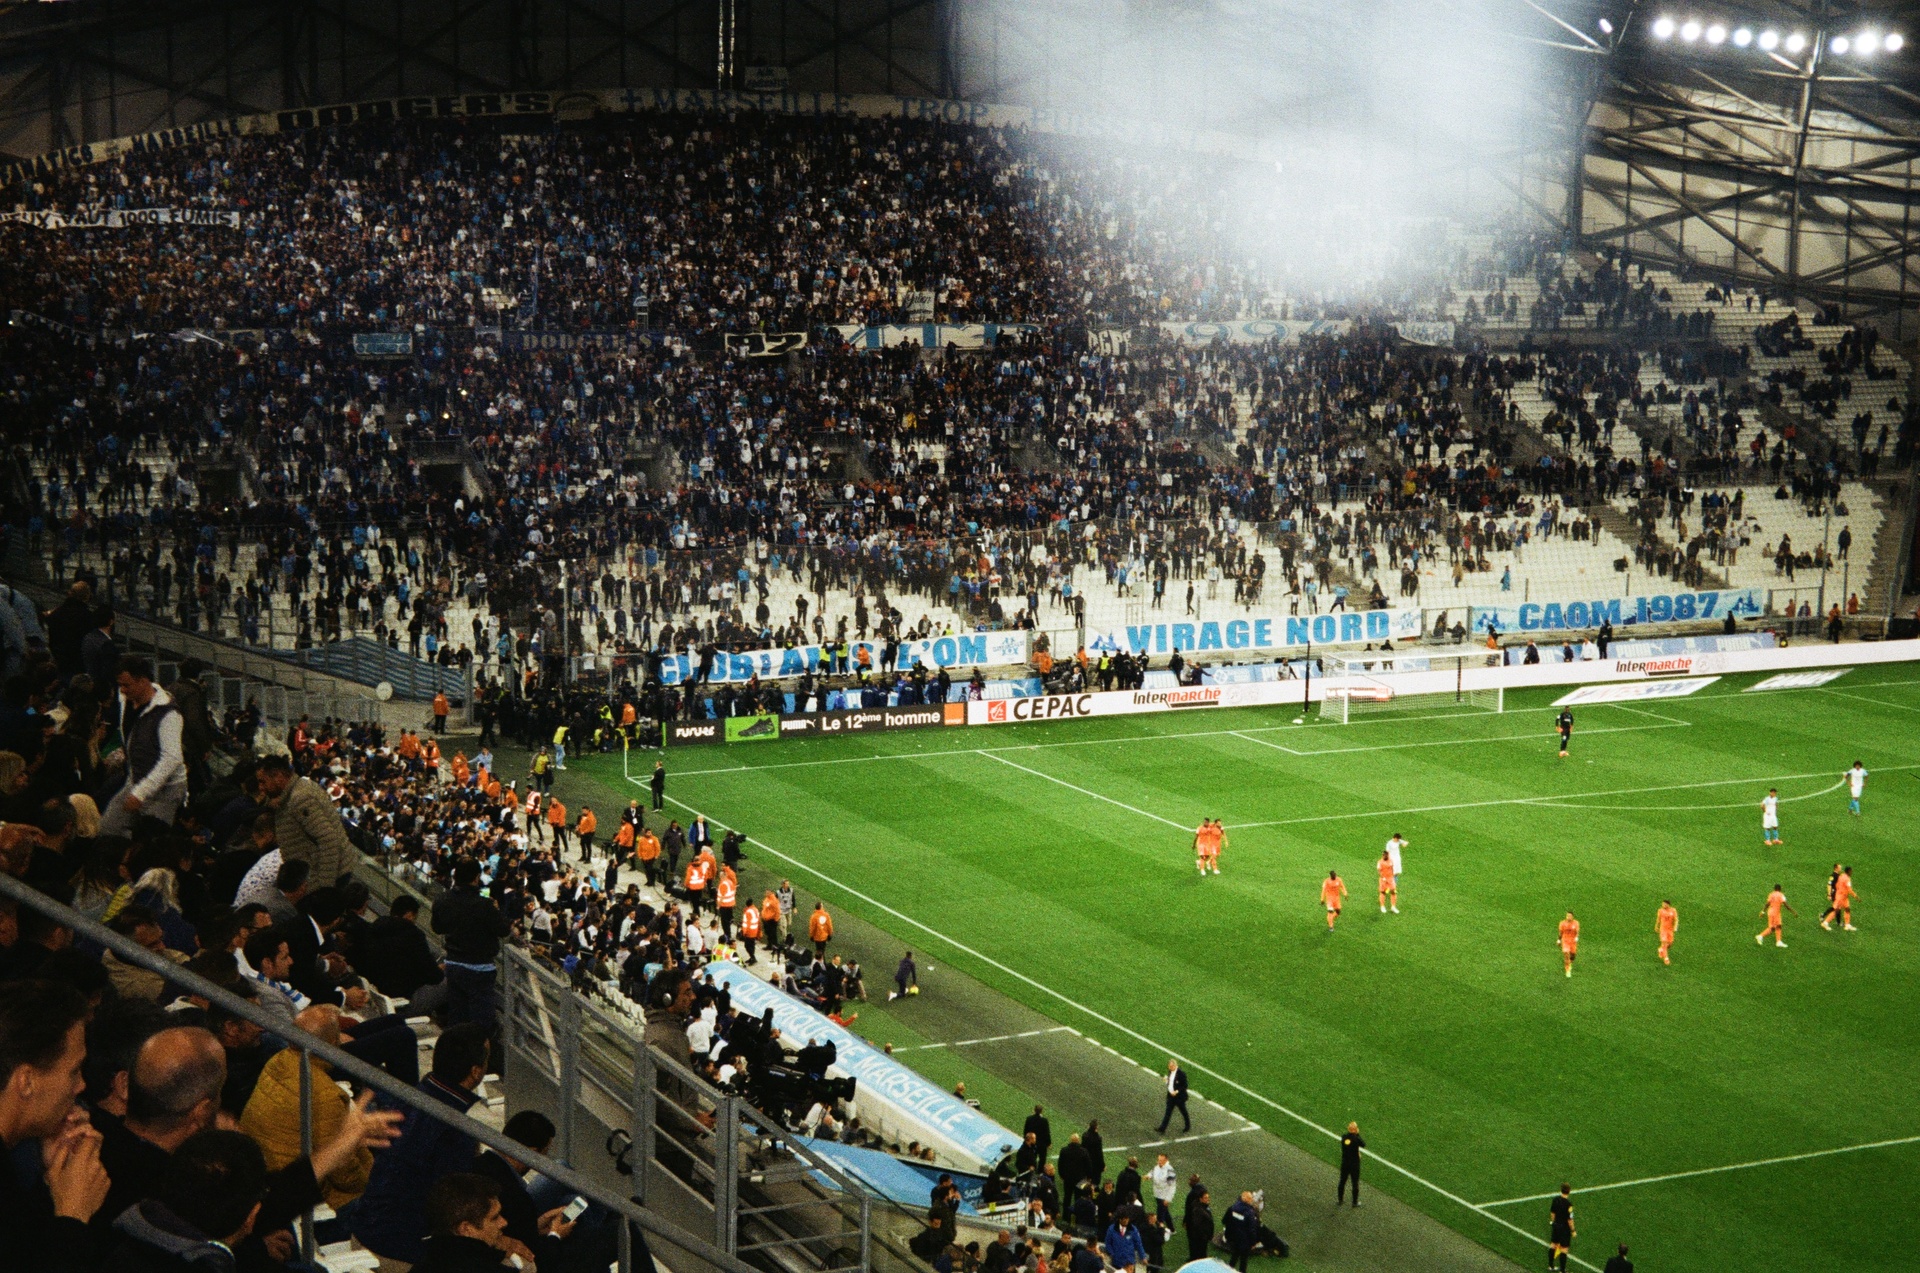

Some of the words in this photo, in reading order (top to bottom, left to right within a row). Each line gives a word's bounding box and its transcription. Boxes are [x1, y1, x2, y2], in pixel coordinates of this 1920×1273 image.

[898, 96, 990, 125] TROP
[170, 208, 232, 225] FUMIS
[1518, 600, 1622, 631] CAOM
[1636, 592, 1720, 624] 1987
[1125, 618, 1273, 653] VIRAGE
[1286, 611, 1391, 645] NORD
[658, 651, 754, 684] CLUB
[897, 635, 988, 670] L'OM
[822, 716, 841, 731] Le
[845, 713, 882, 729] 12ème
[885, 711, 941, 727] homme
[1012, 694, 1092, 720] CEPAC
[734, 981, 837, 1045] OLYMPIQUE
[835, 1037, 867, 1064] DE
[853, 1055, 975, 1131] MARSEILLE
